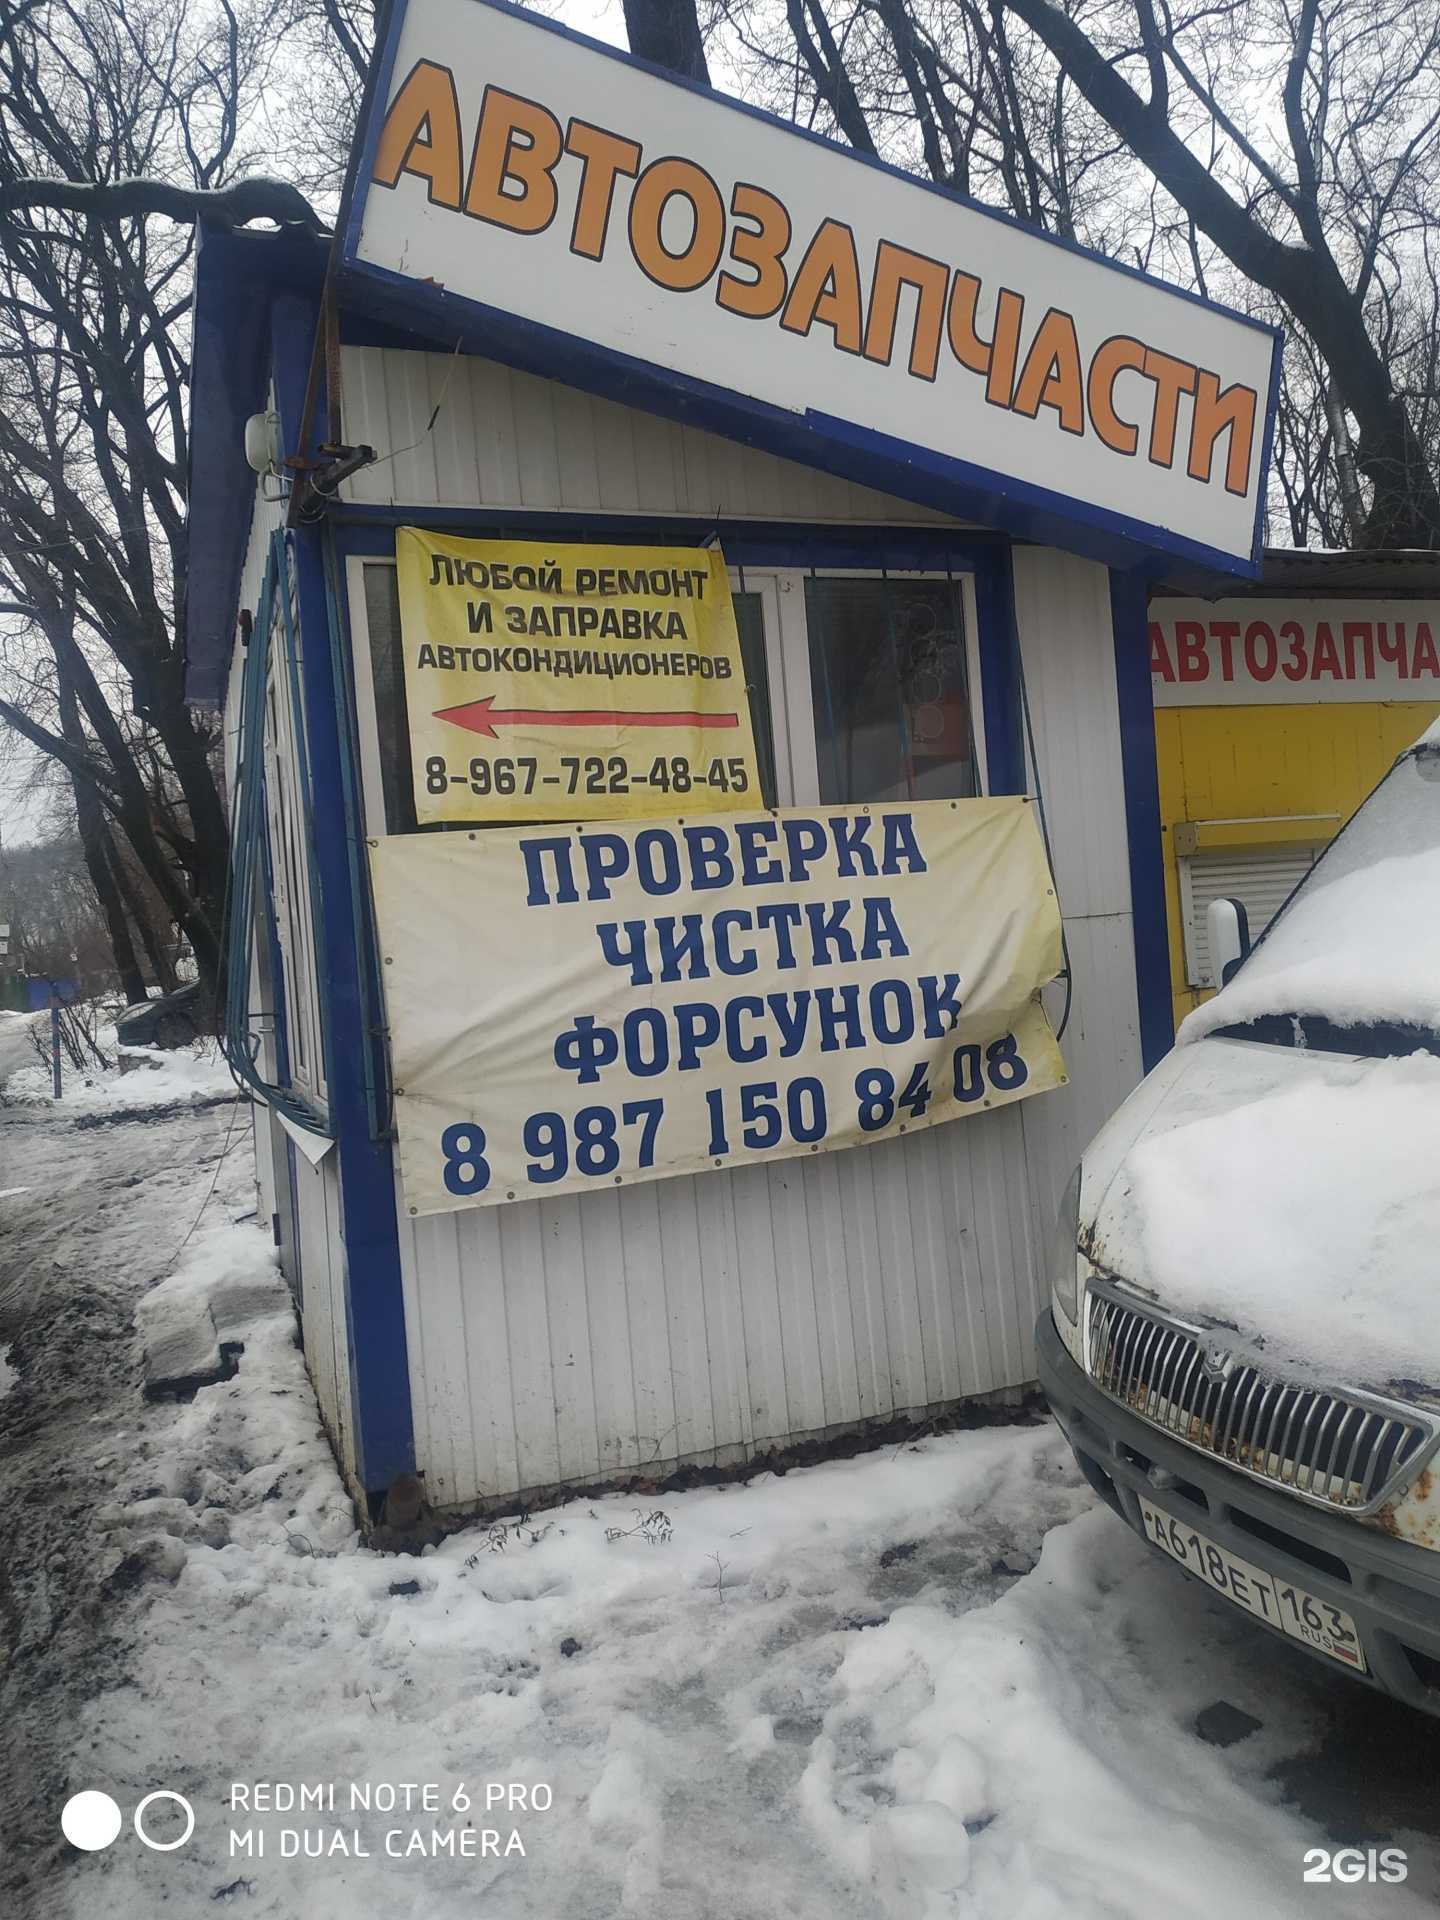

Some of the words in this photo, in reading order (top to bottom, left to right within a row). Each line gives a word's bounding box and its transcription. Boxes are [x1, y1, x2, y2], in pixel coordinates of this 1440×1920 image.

[371, 57, 1257, 498] АВТОЗАПЧАСТИ
[429, 554, 562, 594] ЛЮБОЙ
[575, 568, 708, 599] РЕМОНТ
[467, 602, 493, 633] И
[507, 606, 688, 640] ЗАПРАВКА
[417, 644, 732, 680] АВТОКОНДИЦИОНЕРОВ
[426, 756, 749, 794] 8-967-722-48-45
[519, 813, 927, 906] ПРОВЕРКА
[596, 897, 909, 986] ЧИСТКА
[553, 973, 961, 1084] ФОРСУНОК
[441, 1122, 491, 1196] 8
[522, 1098, 664, 1184] 987
[705, 1076, 827, 1155] 150
[854, 1062, 933, 1132] 84
[952, 1034, 1028, 1103] 08
[1281, 1587, 1346, 1644] 163
[1300, 1625, 1333, 1651] RUS
